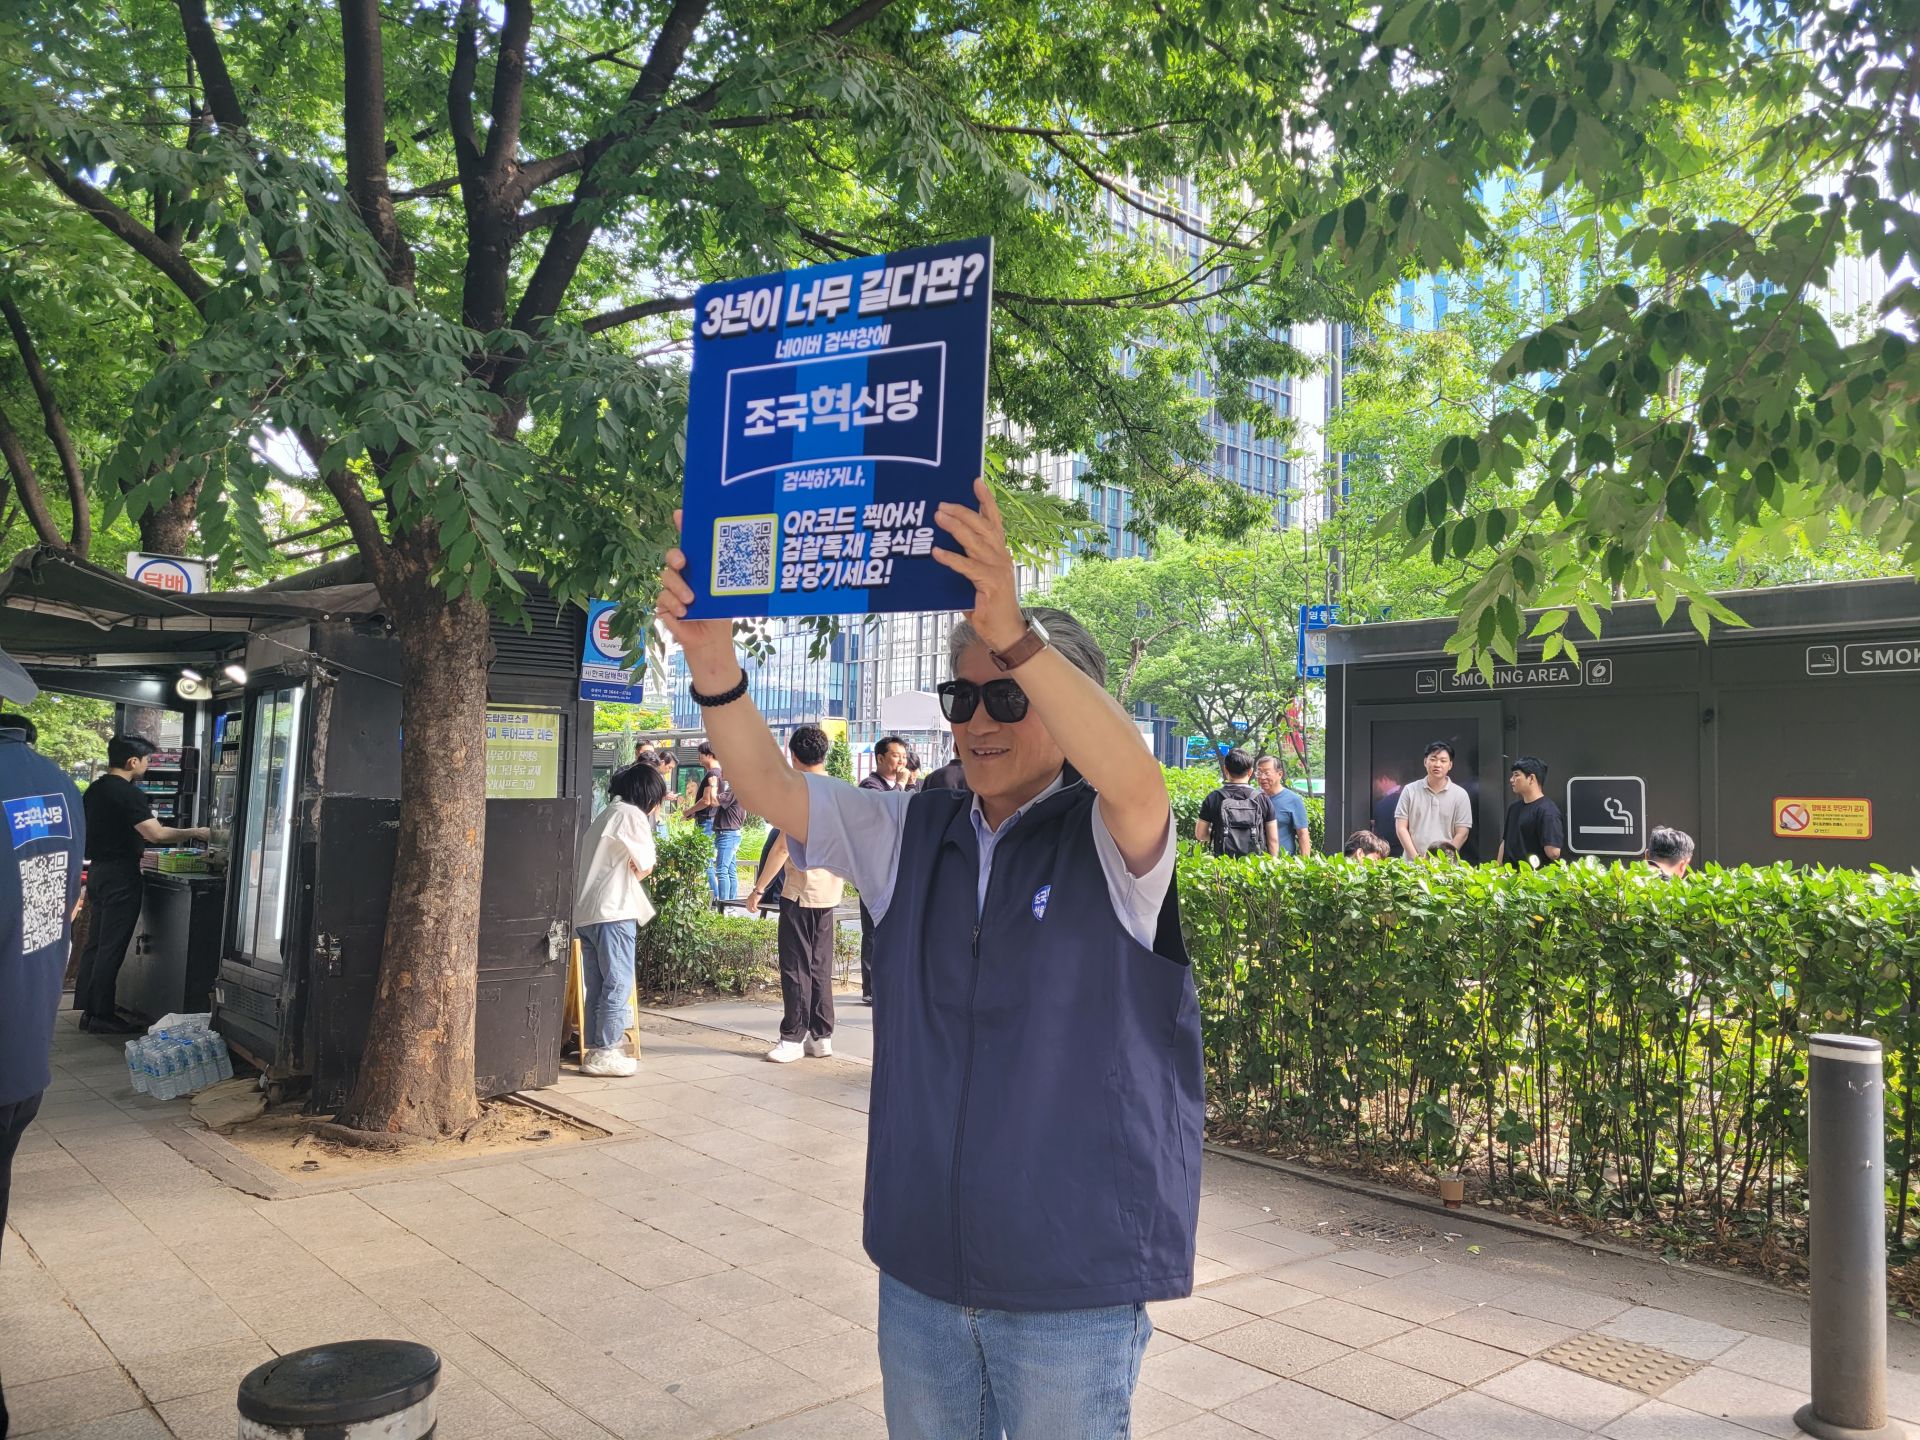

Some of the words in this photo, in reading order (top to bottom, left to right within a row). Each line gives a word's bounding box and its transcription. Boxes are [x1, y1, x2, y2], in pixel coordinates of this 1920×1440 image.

[701, 285, 783, 336] 3년이
[786, 274, 854, 323] 너무
[858, 252, 985, 314] 길다면?
[775, 338, 821, 360] 네이버
[824, 324, 892, 354] 검색창에
[743, 379, 923, 436] 조국혁신당
[783, 506, 857, 536] QR코드
[862, 501, 926, 530] 찍어서
[781, 533, 864, 562] 검찰독재
[869, 526, 935, 557] 종식을
[143, 572, 184, 592] 담배
[780, 559, 893, 590] 앞당기세요!
[1451, 669, 1524, 687] SMOING
[1527, 667, 1570, 683] AREA
[13, 805, 63, 830] 조국혁신당
